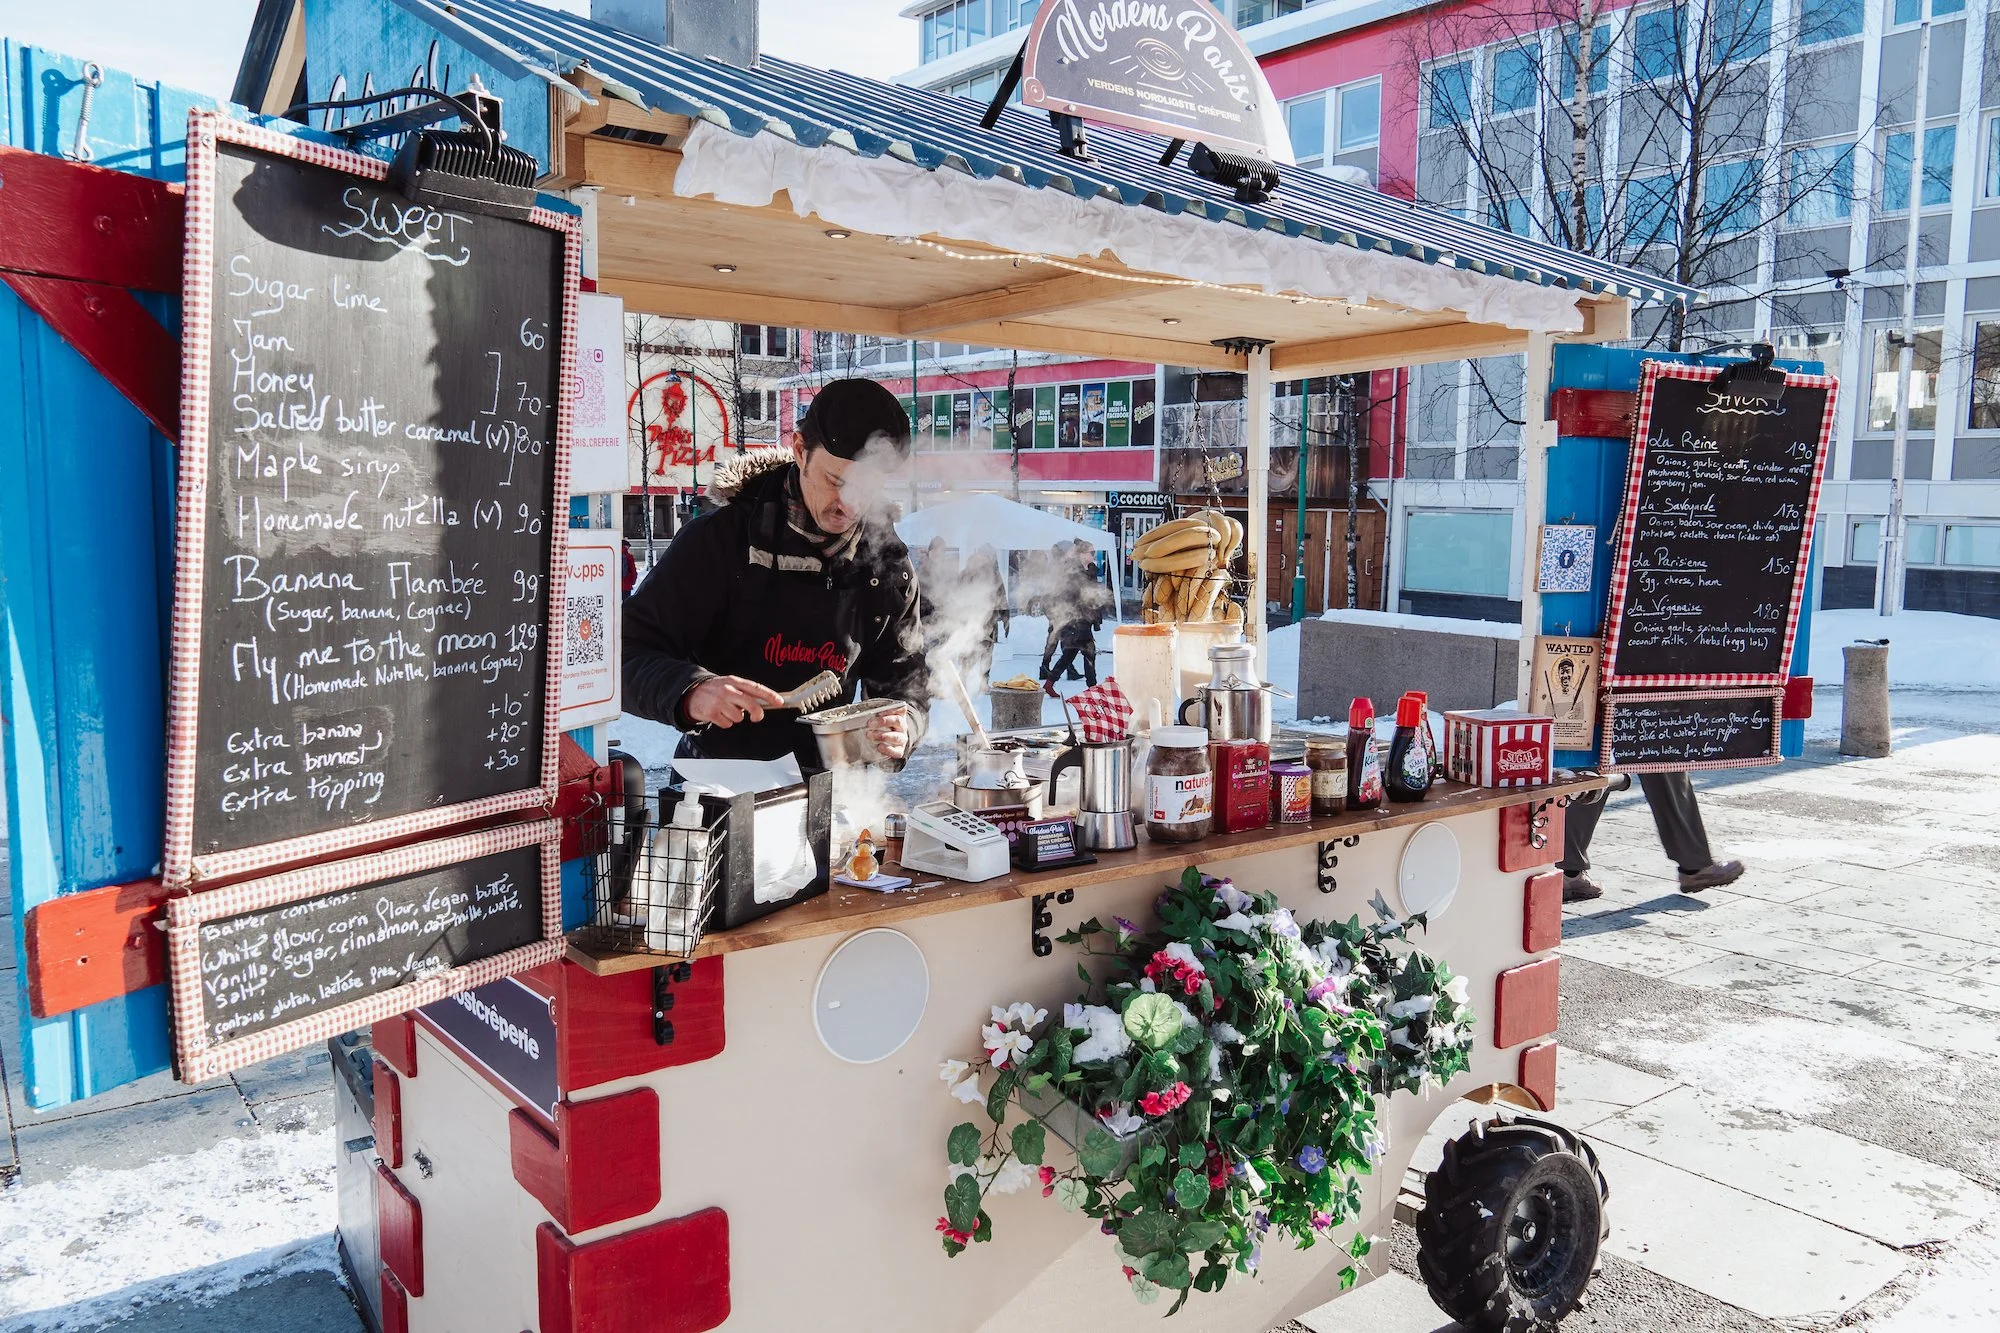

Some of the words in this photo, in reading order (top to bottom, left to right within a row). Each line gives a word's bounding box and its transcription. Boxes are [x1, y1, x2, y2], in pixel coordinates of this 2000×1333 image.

[1176, 9, 1251, 105] Paris
[1087, 77, 1135, 97] VERDENS
[1136, 88, 1197, 113] NORDLIGSTE
[229, 255, 316, 316] Sugar
[230, 319, 296, 362] Jam
[233, 357, 316, 419] Honey
[232, 393, 332, 434] Salted
[336, 398, 397, 437] butter
[404, 420, 482, 445] caramel
[1681, 431, 1719, 451] Reine
[236, 442, 323, 502] Maple
[1753, 462, 1784, 472] reindeer
[239, 490, 364, 550] Homemade
[223, 554, 365, 603] Banana
[387, 560, 488, 600] Flambée
[1654, 546, 1708, 568] Parisienne
[1698, 574, 1723, 587] ham
[265, 597, 335, 632] (Sugar,
[341, 600, 401, 623] banana,
[406, 597, 473, 633] Cognac)
[765, 632, 818, 667] Nordens
[1545, 643, 1594, 654] WANTED
[1627, 635, 1661, 647] coconut
[231, 635, 281, 706] Fly
[298, 645, 341, 669] me
[378, 632, 427, 661] the
[436, 630, 498, 657] moon
[281, 671, 369, 703] (Homemade
[480, 652, 525, 684] Cognac)
[222, 754, 294, 784] Extra
[303, 731, 385, 773] brunost
[226, 726, 291, 755] Extra
[298, 721, 364, 747] banana
[1506, 751, 1534, 763] SUGAR
[220, 784, 298, 814] Extra
[306, 769, 387, 812] topping
[200, 914, 269, 943] Batter
[280, 891, 357, 920] contains:
[201, 932, 269, 974] White
[328, 911, 369, 934] corn
[283, 945, 338, 979] sugar,
[214, 1008, 266, 1035] contains
[319, 969, 364, 1000] lactose
